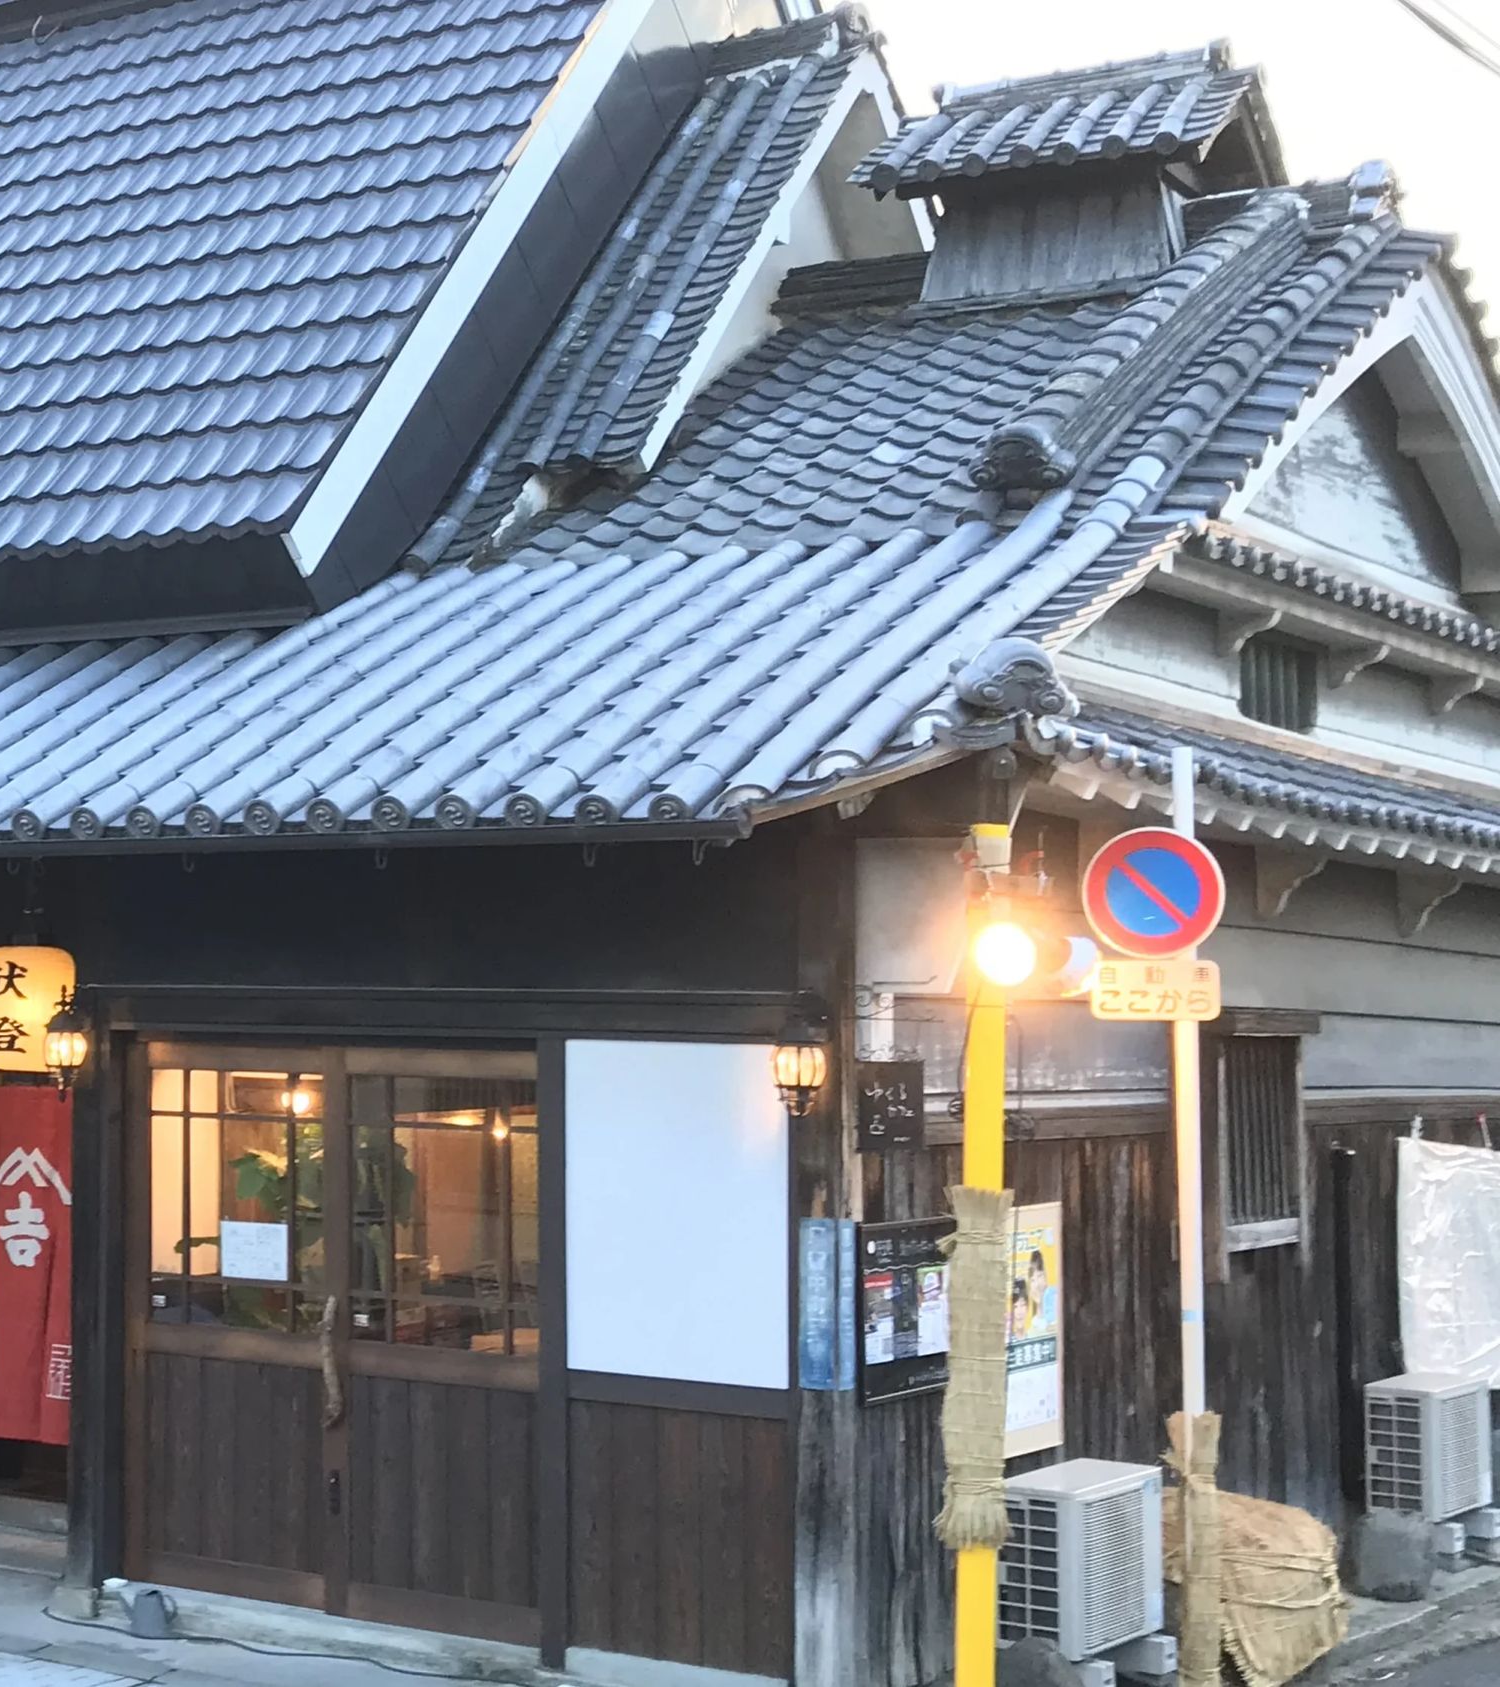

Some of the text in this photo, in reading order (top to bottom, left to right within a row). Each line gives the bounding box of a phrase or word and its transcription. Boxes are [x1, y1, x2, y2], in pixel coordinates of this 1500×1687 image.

[1100, 966, 1210, 985] 自動車
[1099, 989, 1212, 1014] ここから
